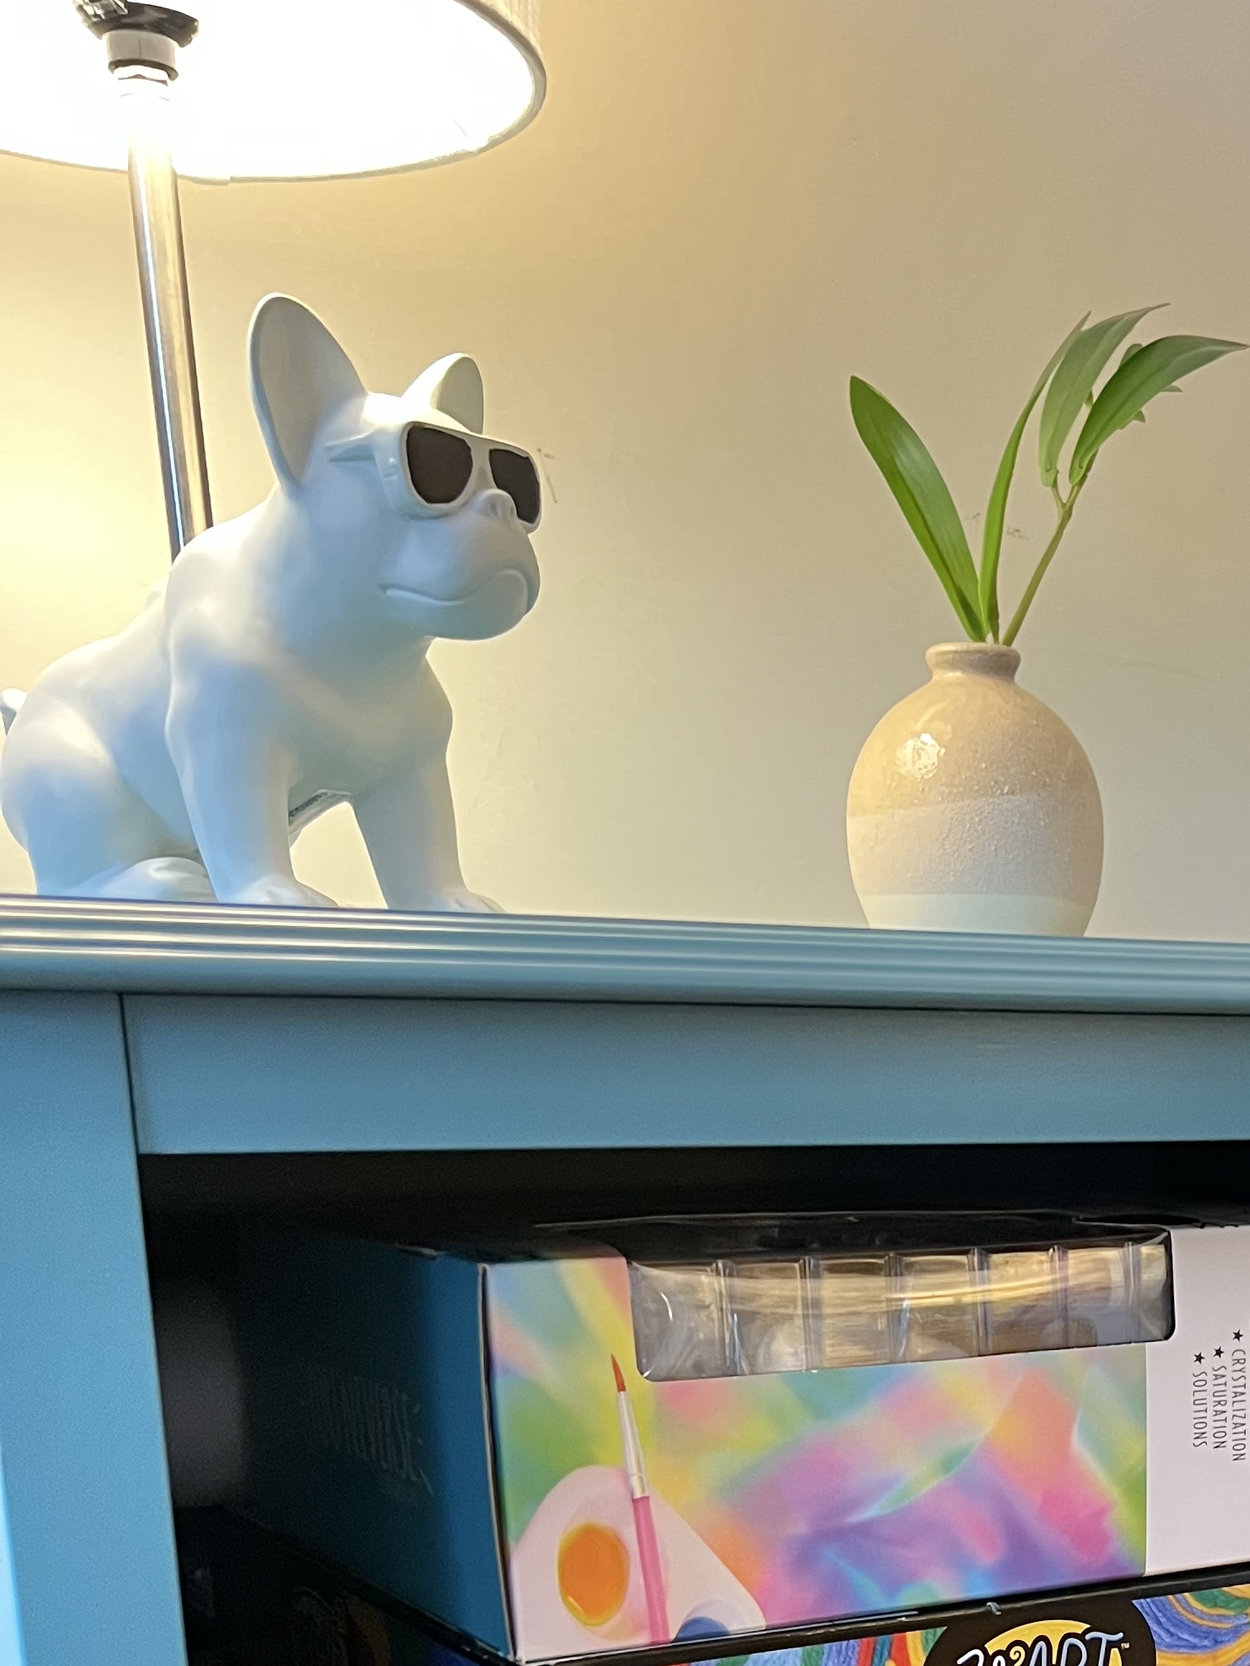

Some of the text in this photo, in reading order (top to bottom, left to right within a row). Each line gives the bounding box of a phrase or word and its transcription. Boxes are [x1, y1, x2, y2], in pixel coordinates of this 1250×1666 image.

[1192, 1371, 1208, 1448] SOLUTIONS
[1212, 1365, 1228, 1450] SATURATION
[1231, 1348, 1247, 1462] CRYSTALIZATION
